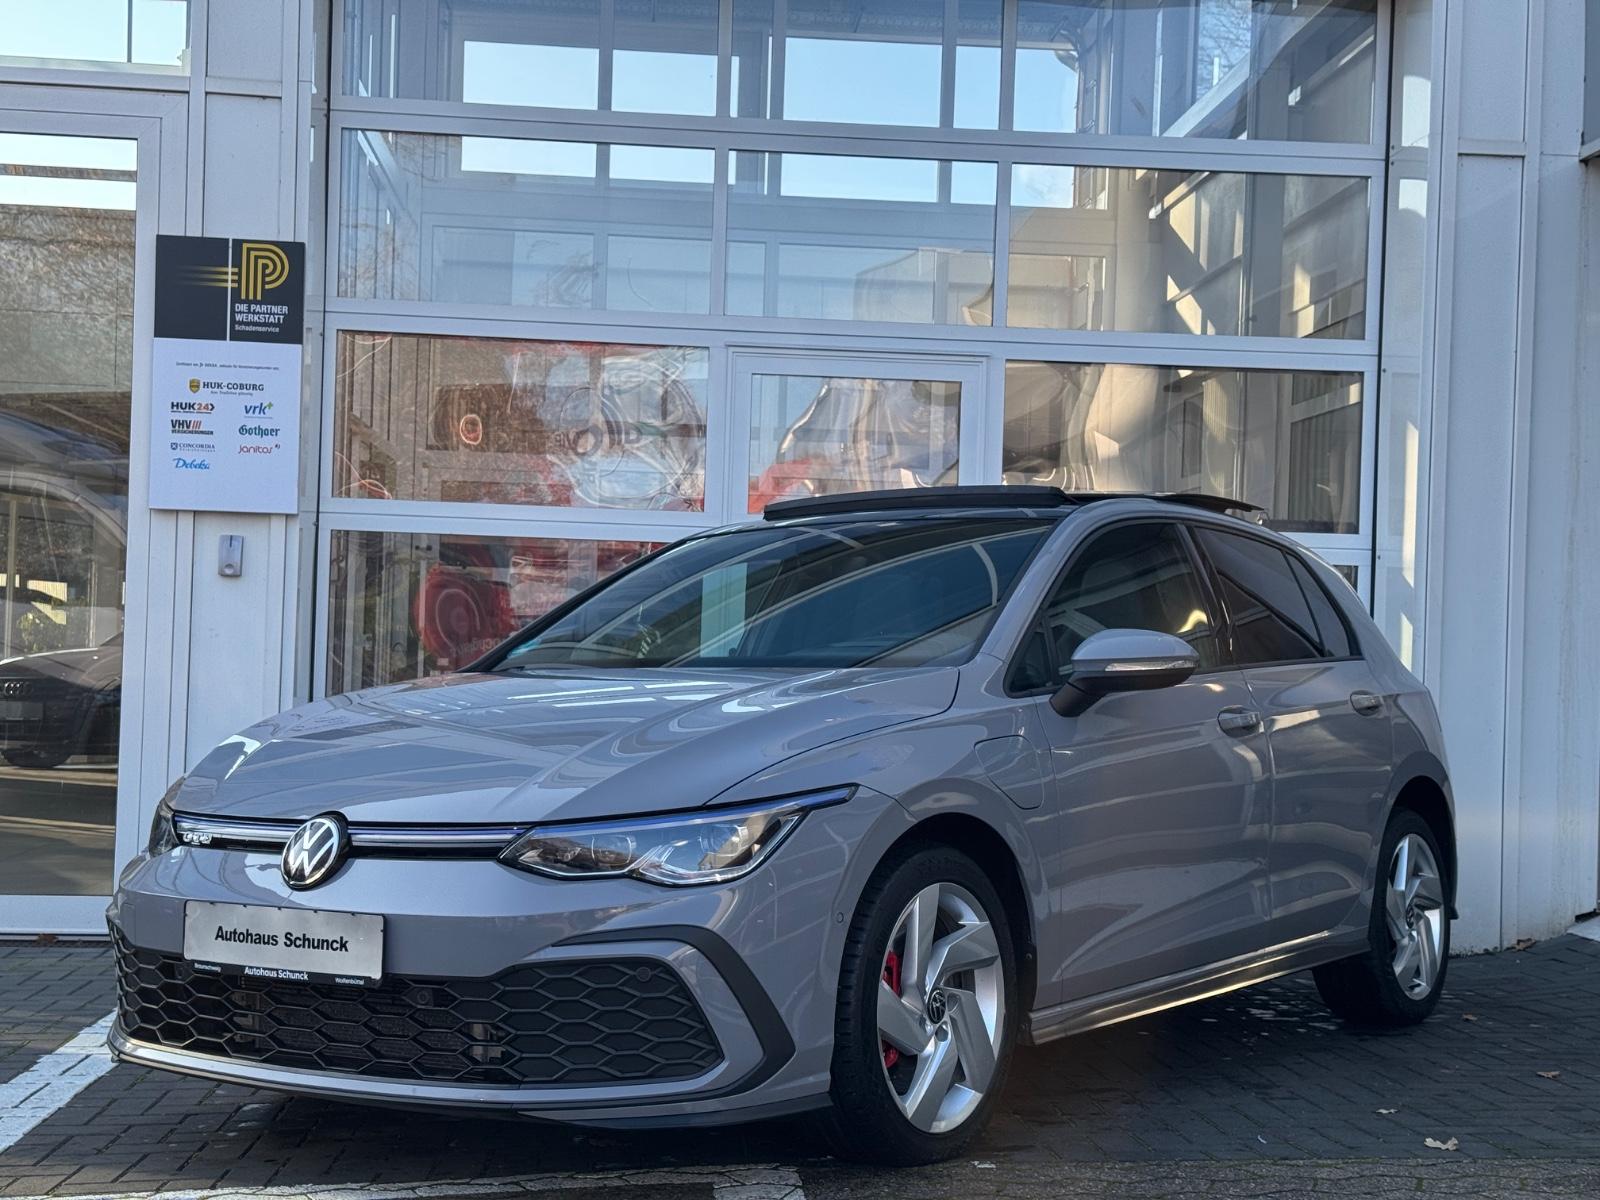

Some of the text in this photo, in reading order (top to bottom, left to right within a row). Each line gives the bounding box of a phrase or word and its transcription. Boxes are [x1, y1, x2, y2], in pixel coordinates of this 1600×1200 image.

[234, 303, 289, 314] DIE PARTNER
[234, 313, 285, 324] WERKSTATT
[234, 324, 280, 333] Schadenservice
[202, 381, 265, 392] HUK-COBURG
[238, 424, 280, 438] Gothaer
[172, 457, 210, 470] Debeka
[215, 925, 349, 952] Autohaus Schunck
[244, 966, 278, 978] Autohaus
[278, 969, 309, 981] Schunck
